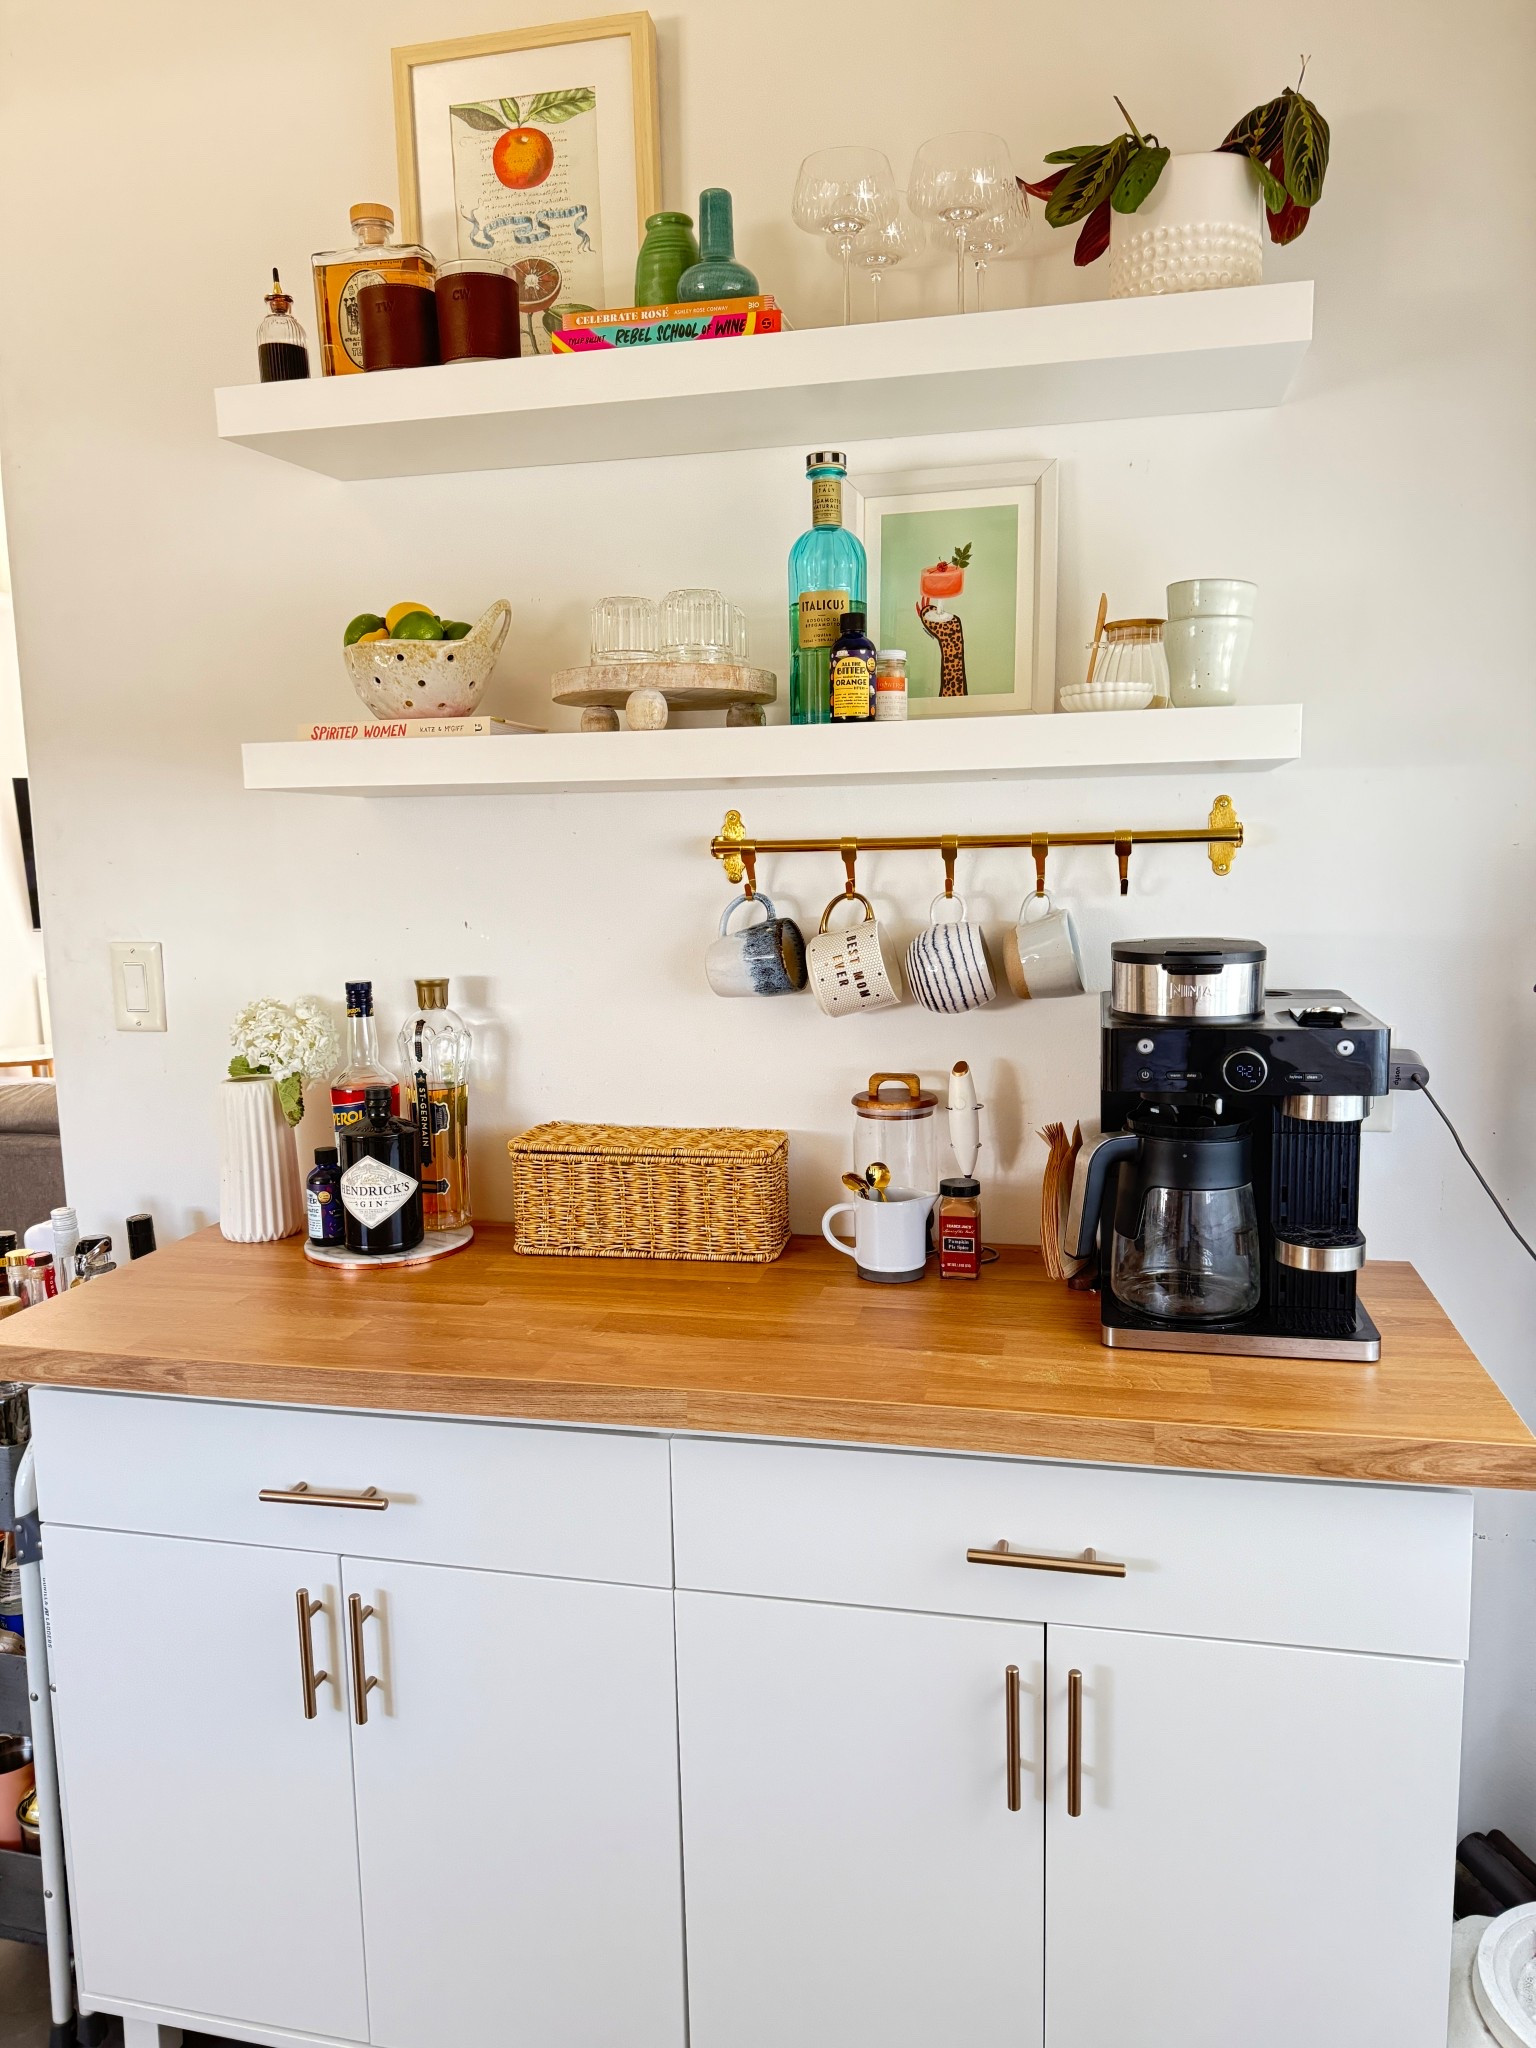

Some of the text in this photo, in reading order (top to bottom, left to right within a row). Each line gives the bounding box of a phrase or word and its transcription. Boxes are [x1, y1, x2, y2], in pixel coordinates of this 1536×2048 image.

[375, 301, 394, 314] TW
[575, 307, 669, 326] CELEBRATE ROSÉ
[615, 318, 746, 346] REBEL SCHOOL OF WINE
[802, 599, 845, 612] ITALICUS
[836, 666, 866, 675] BITTER
[836, 678, 867, 687] ORANGE
[364, 723, 407, 738] WOMEN
[832, 954, 849, 987] EVER
[846, 935, 871, 998] BEST MOM
[1169, 982, 1213, 1000] NINJA
[1236, 1065, 1261, 1078] 9:21
[332, 1109, 363, 1126] PEROL
[419, 1087, 430, 1147] ST-GERMAIN
[341, 1181, 410, 1196] HENDRICK'S
[360, 1200, 383, 1208] GIN
